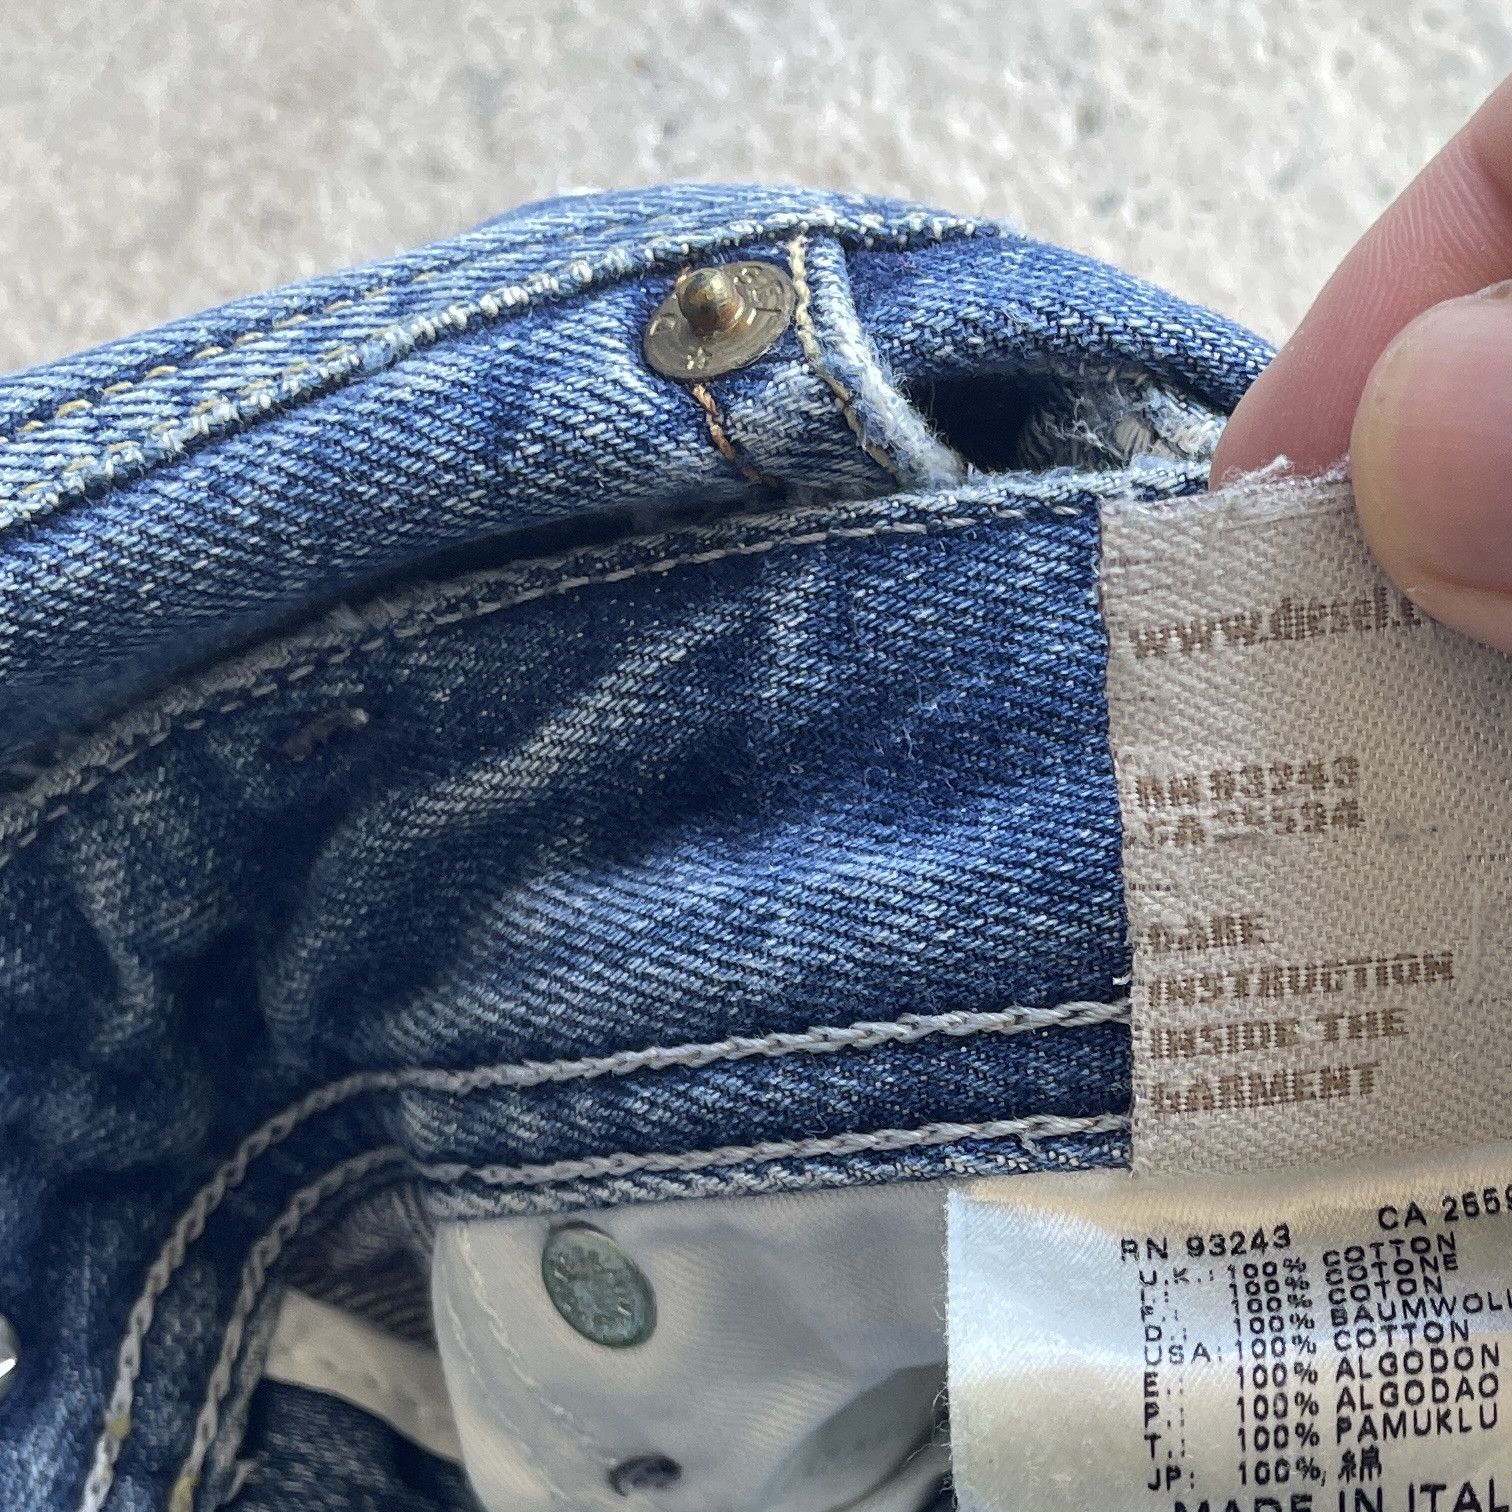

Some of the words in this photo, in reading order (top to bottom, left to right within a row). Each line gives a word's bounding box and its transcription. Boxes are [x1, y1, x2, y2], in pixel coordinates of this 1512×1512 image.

[1150, 1018, 1300, 1059] INSIDE
[1315, 1008, 1409, 1041] THE
[1150, 1061, 1381, 1114] GARMENT
[1120, 1237, 1168, 1261] RN
[1186, 1222, 1292, 1258] 93243
[1378, 1201, 1427, 1230] CA
[1322, 1231, 1457, 1267] COTTON
[1325, 1253, 1459, 1286] COTONE
[1328, 1276, 1443, 1306] COTON
[1333, 1319, 1469, 1351] COTTON
[1236, 1361, 1319, 1391] 100%
[1335, 1341, 1500, 1383] ALGODON
[1237, 1391, 1320, 1423] 100%
[1336, 1372, 1500, 1413] ALGODAO
[1237, 1422, 1321, 1452] 100%
[1336, 1402, 1498, 1445] PAMUKLU
